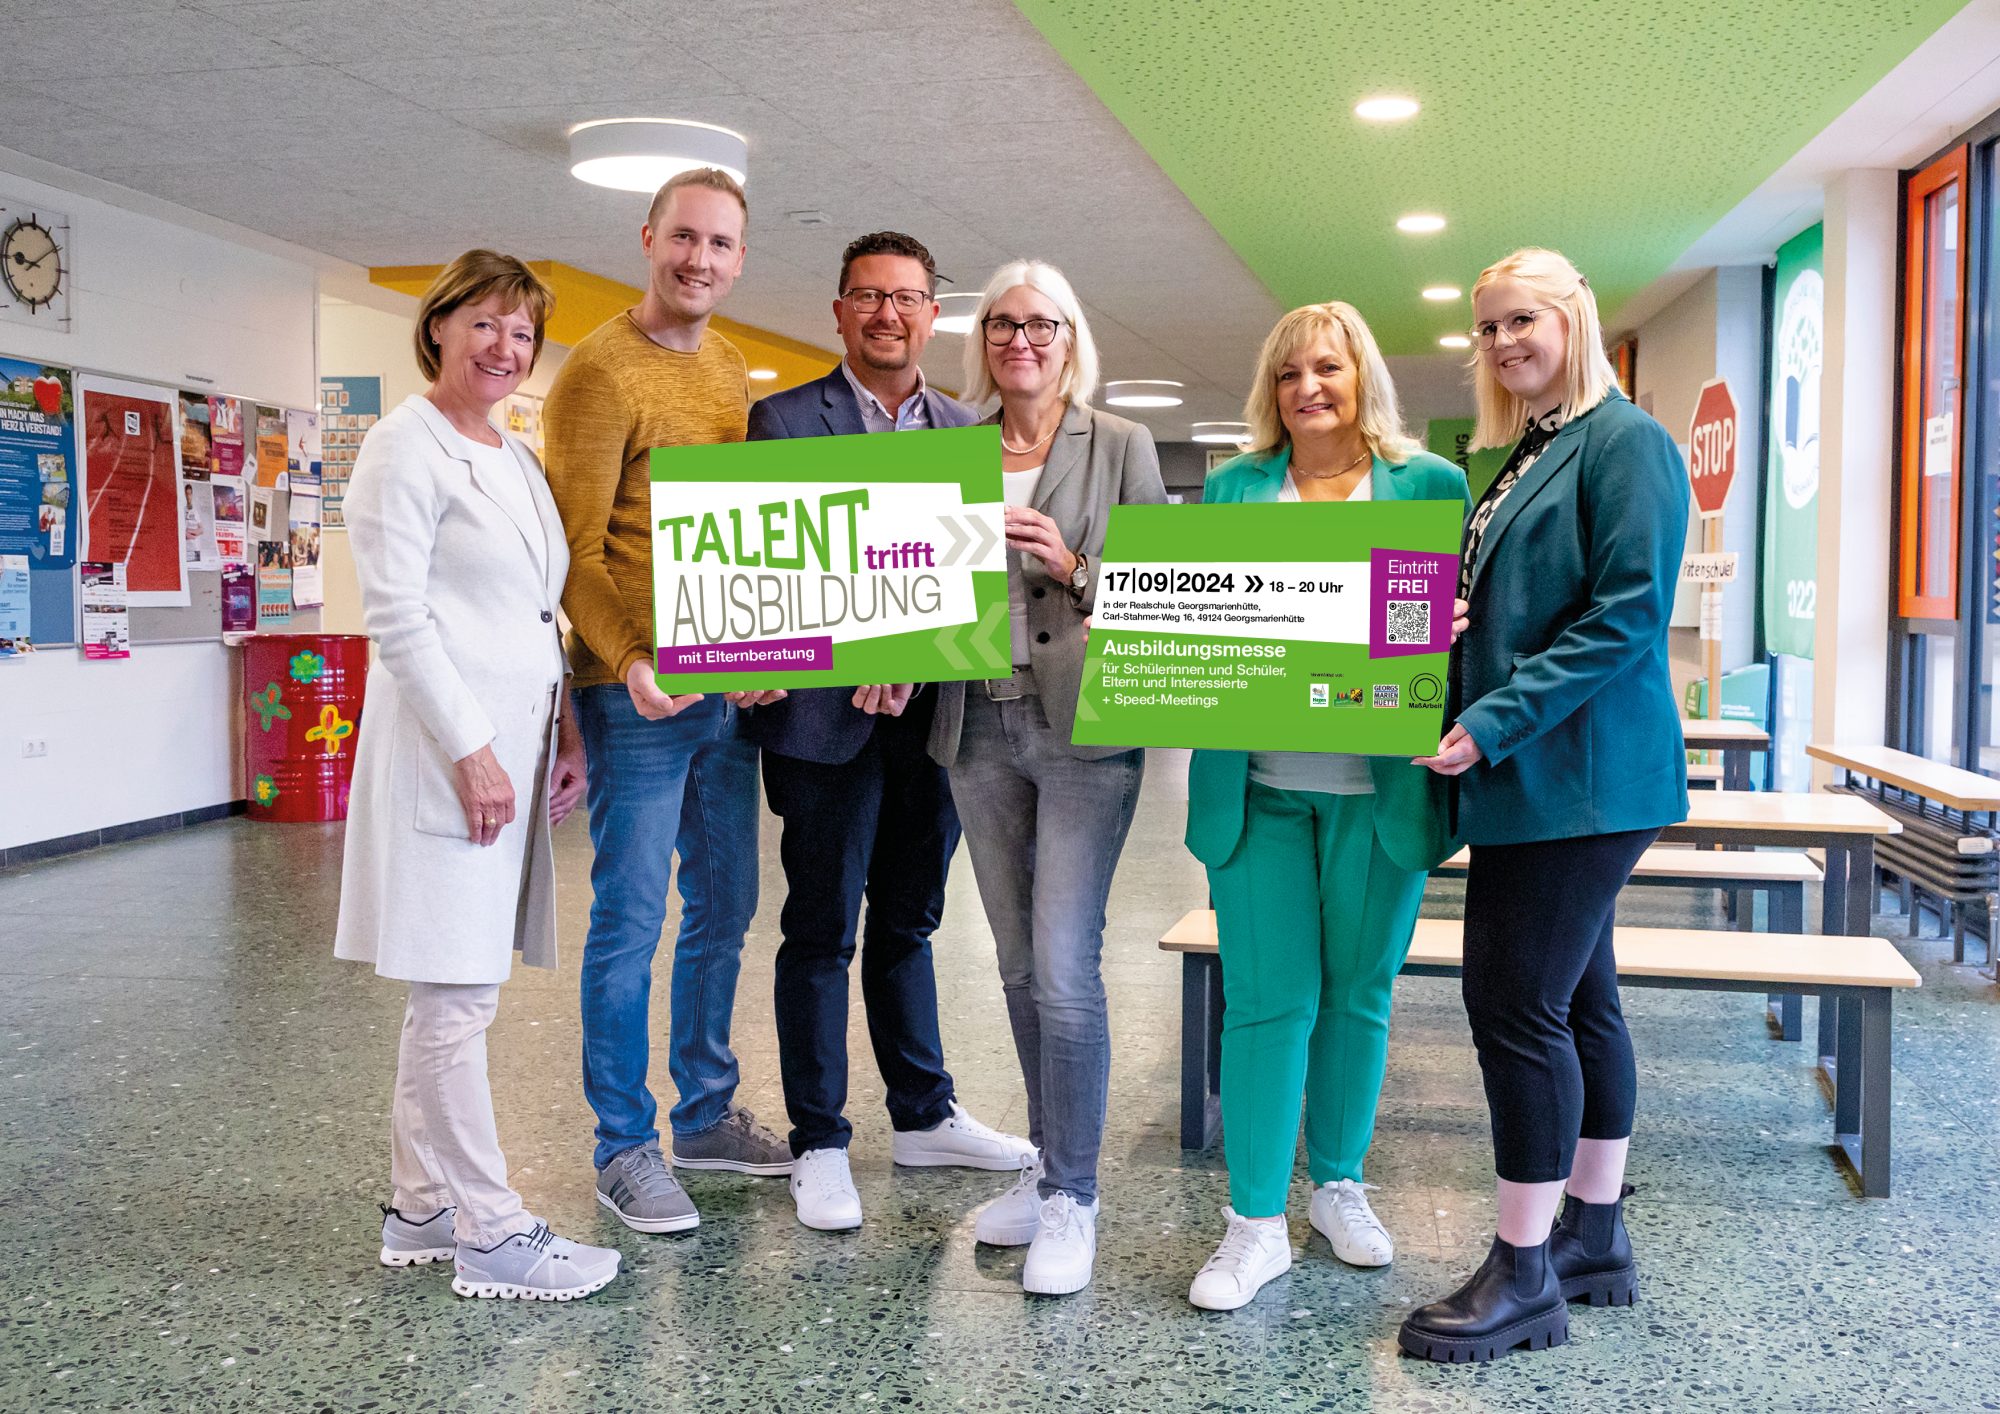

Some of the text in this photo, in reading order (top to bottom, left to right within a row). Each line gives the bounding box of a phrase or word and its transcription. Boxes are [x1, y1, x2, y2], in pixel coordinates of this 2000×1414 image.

[29, 412, 45, 423] WAS
[1, 419, 19, 432] HERZ
[25, 422, 62, 436] VERSTAND!
[1692, 416, 1734, 479] STOP
[658, 488, 935, 574] TALENT trifft
[1388, 559, 1439, 575] Eintritt
[1269, 581, 1284, 593] 18
[1298, 581, 1315, 593] 20
[1319, 581, 1343, 594] Uhr
[1388, 579, 1428, 594] FREI
[672, 574, 941, 647] AUSBILDUNG
[1103, 601, 1261, 611] in der Realschule Georgsmarienhütte,
[1102, 613, 1305, 624] Carl-Stahmer-Weg 16, 49124 Georgsmarienhütte
[678, 647, 815, 665] mit Elternberatung
[1102, 639, 1286, 660] Ausbildungsmesse
[1102, 663, 1287, 677] für Schülerinnen und Schüler,
[1102, 676, 1248, 689] Eltern und Interessierte
[1114, 693, 1218, 708] Speed-Meetings
